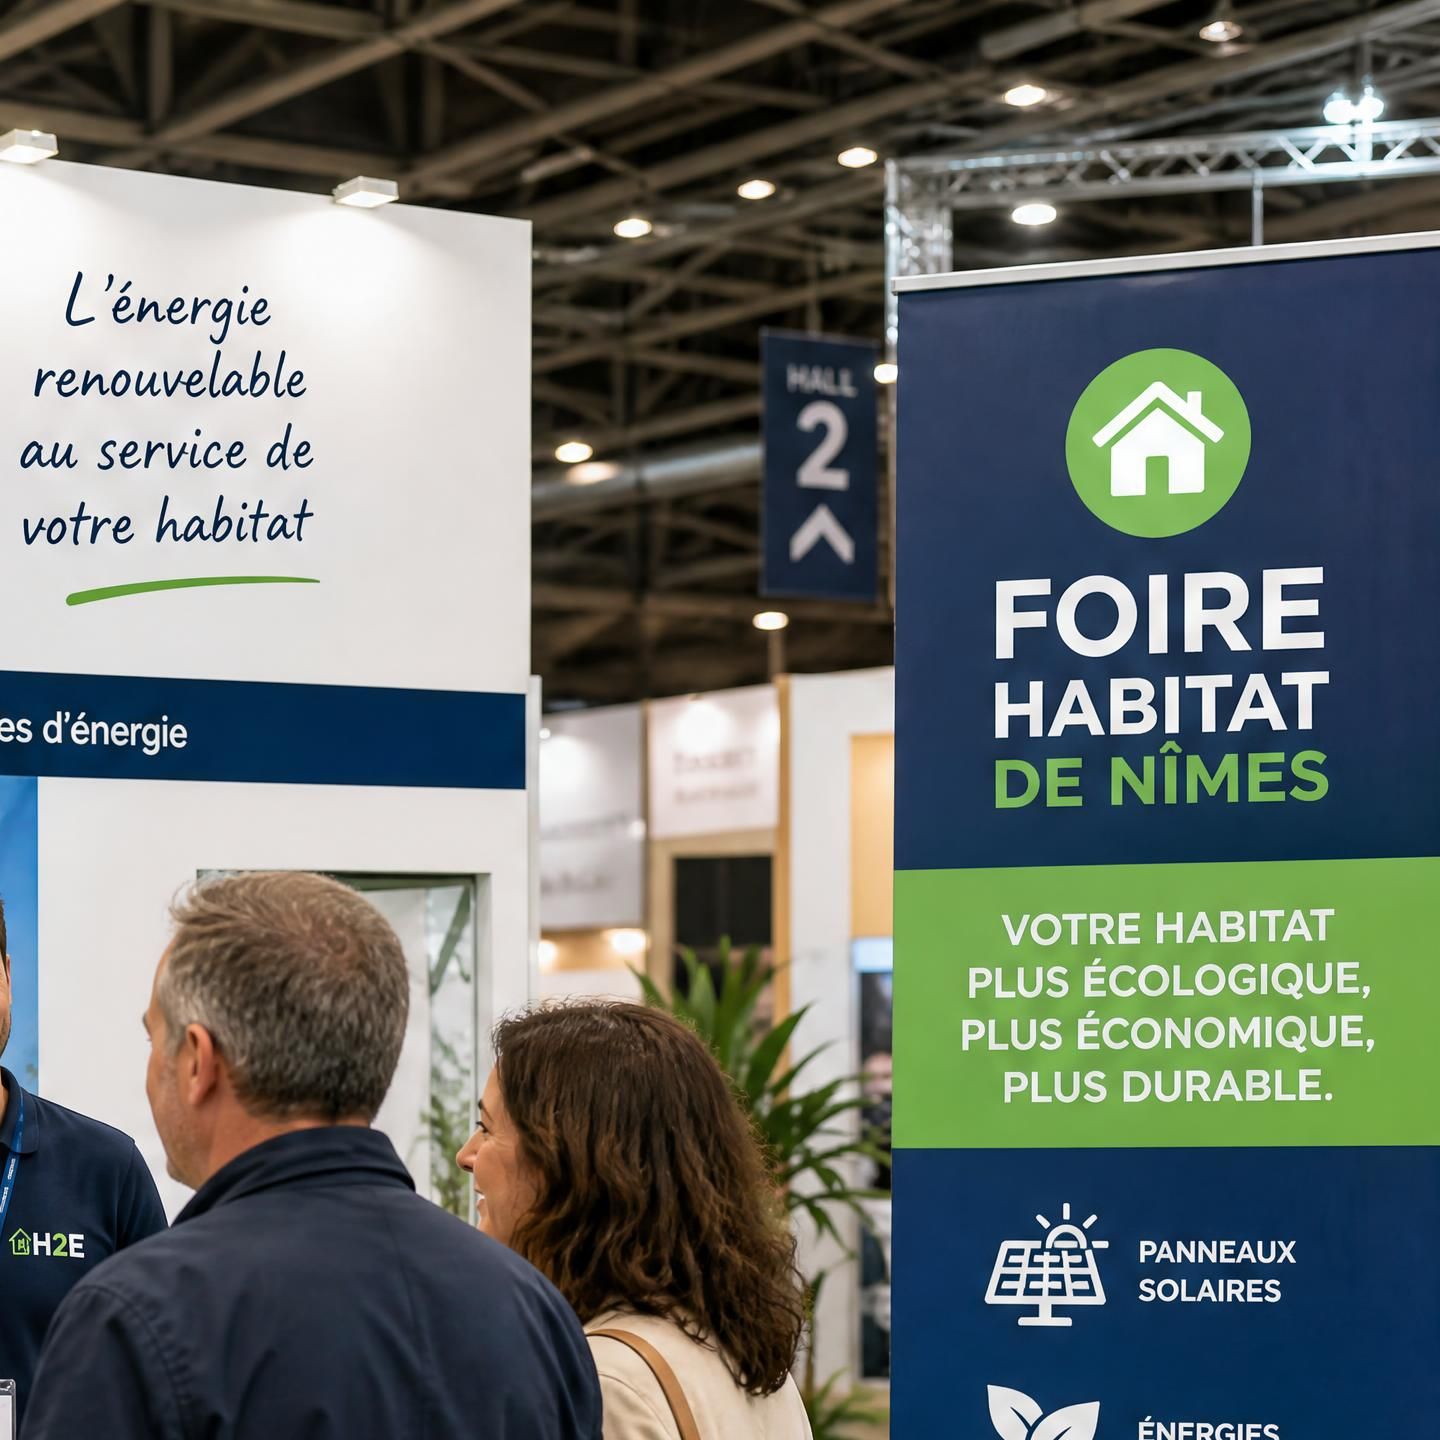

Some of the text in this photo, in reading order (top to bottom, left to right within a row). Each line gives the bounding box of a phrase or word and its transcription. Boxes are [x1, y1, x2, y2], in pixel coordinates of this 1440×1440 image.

[66, 271, 271, 344] L'énergie
[34, 350, 306, 398] renouvelable
[786, 363, 857, 398] HALL
[20, 423, 313, 470] au service de
[798, 402, 848, 490] 2
[24, 495, 314, 545] votre habitat
[996, 567, 1324, 659] FOIRE
[995, 671, 1329, 738] HABITAT
[43, 711, 187, 755] d'énergie
[995, 741, 1328, 808] DE NÎMES
[1002, 909, 1334, 945] VOTRE HABITAT
[969, 958, 1370, 999] PLUS ÉCOLOGIQUE,
[962, 1011, 1374, 1053] PLUS ÉCONOMIQUE,
[1005, 1069, 1332, 1103] PLUS DURABLE.
[33, 1233, 84, 1258] H2E
[1140, 1241, 1296, 1263] PANNEAUX
[1139, 1279, 1281, 1302] SOLAIRES
